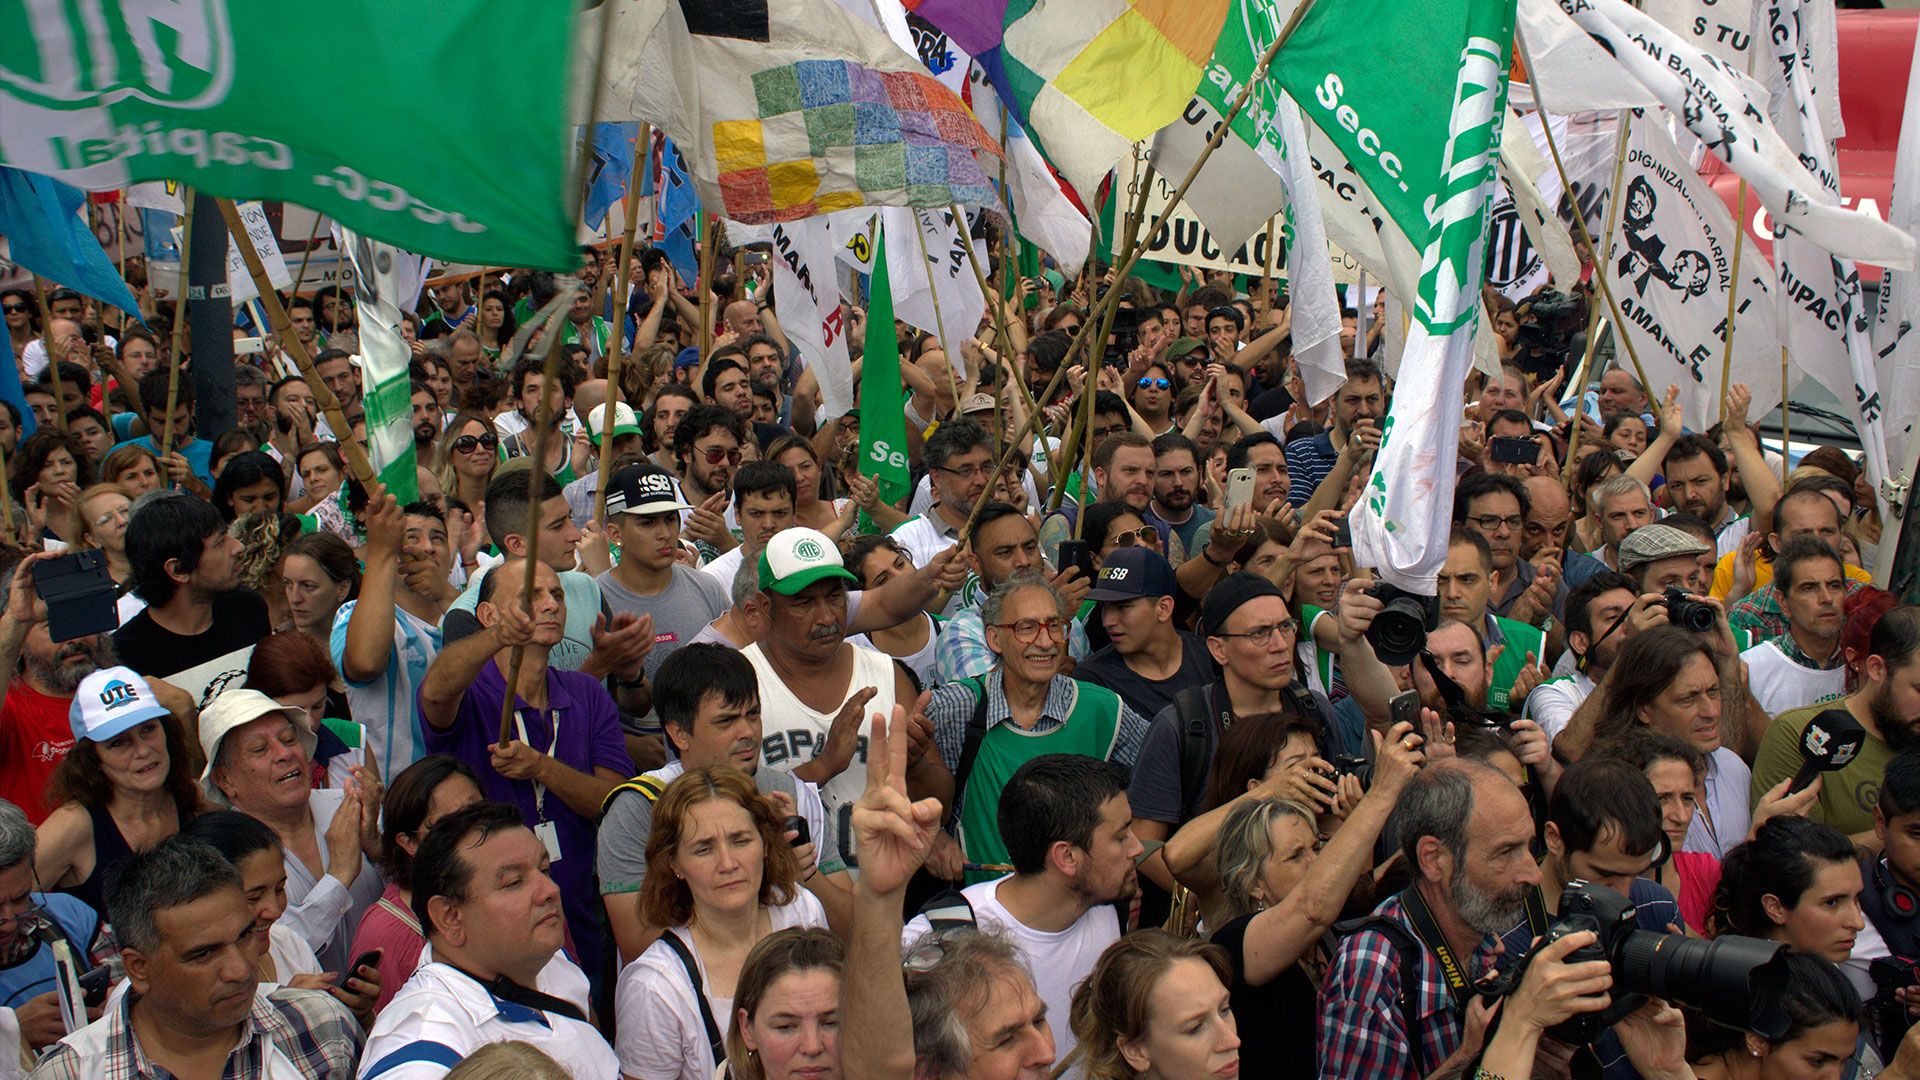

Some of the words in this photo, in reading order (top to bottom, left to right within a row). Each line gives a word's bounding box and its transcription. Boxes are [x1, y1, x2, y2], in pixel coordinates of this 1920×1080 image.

[1667, 53, 1731, 125] BARRIA
[1315, 73, 1409, 192] Secc.
[1310, 155, 1356, 202] PAC
[1781, 261, 1840, 331] TUPAC
[870, 440, 910, 473] Se
[100, 683, 137, 705] UTE
[1436, 946, 1465, 988] Nikon
